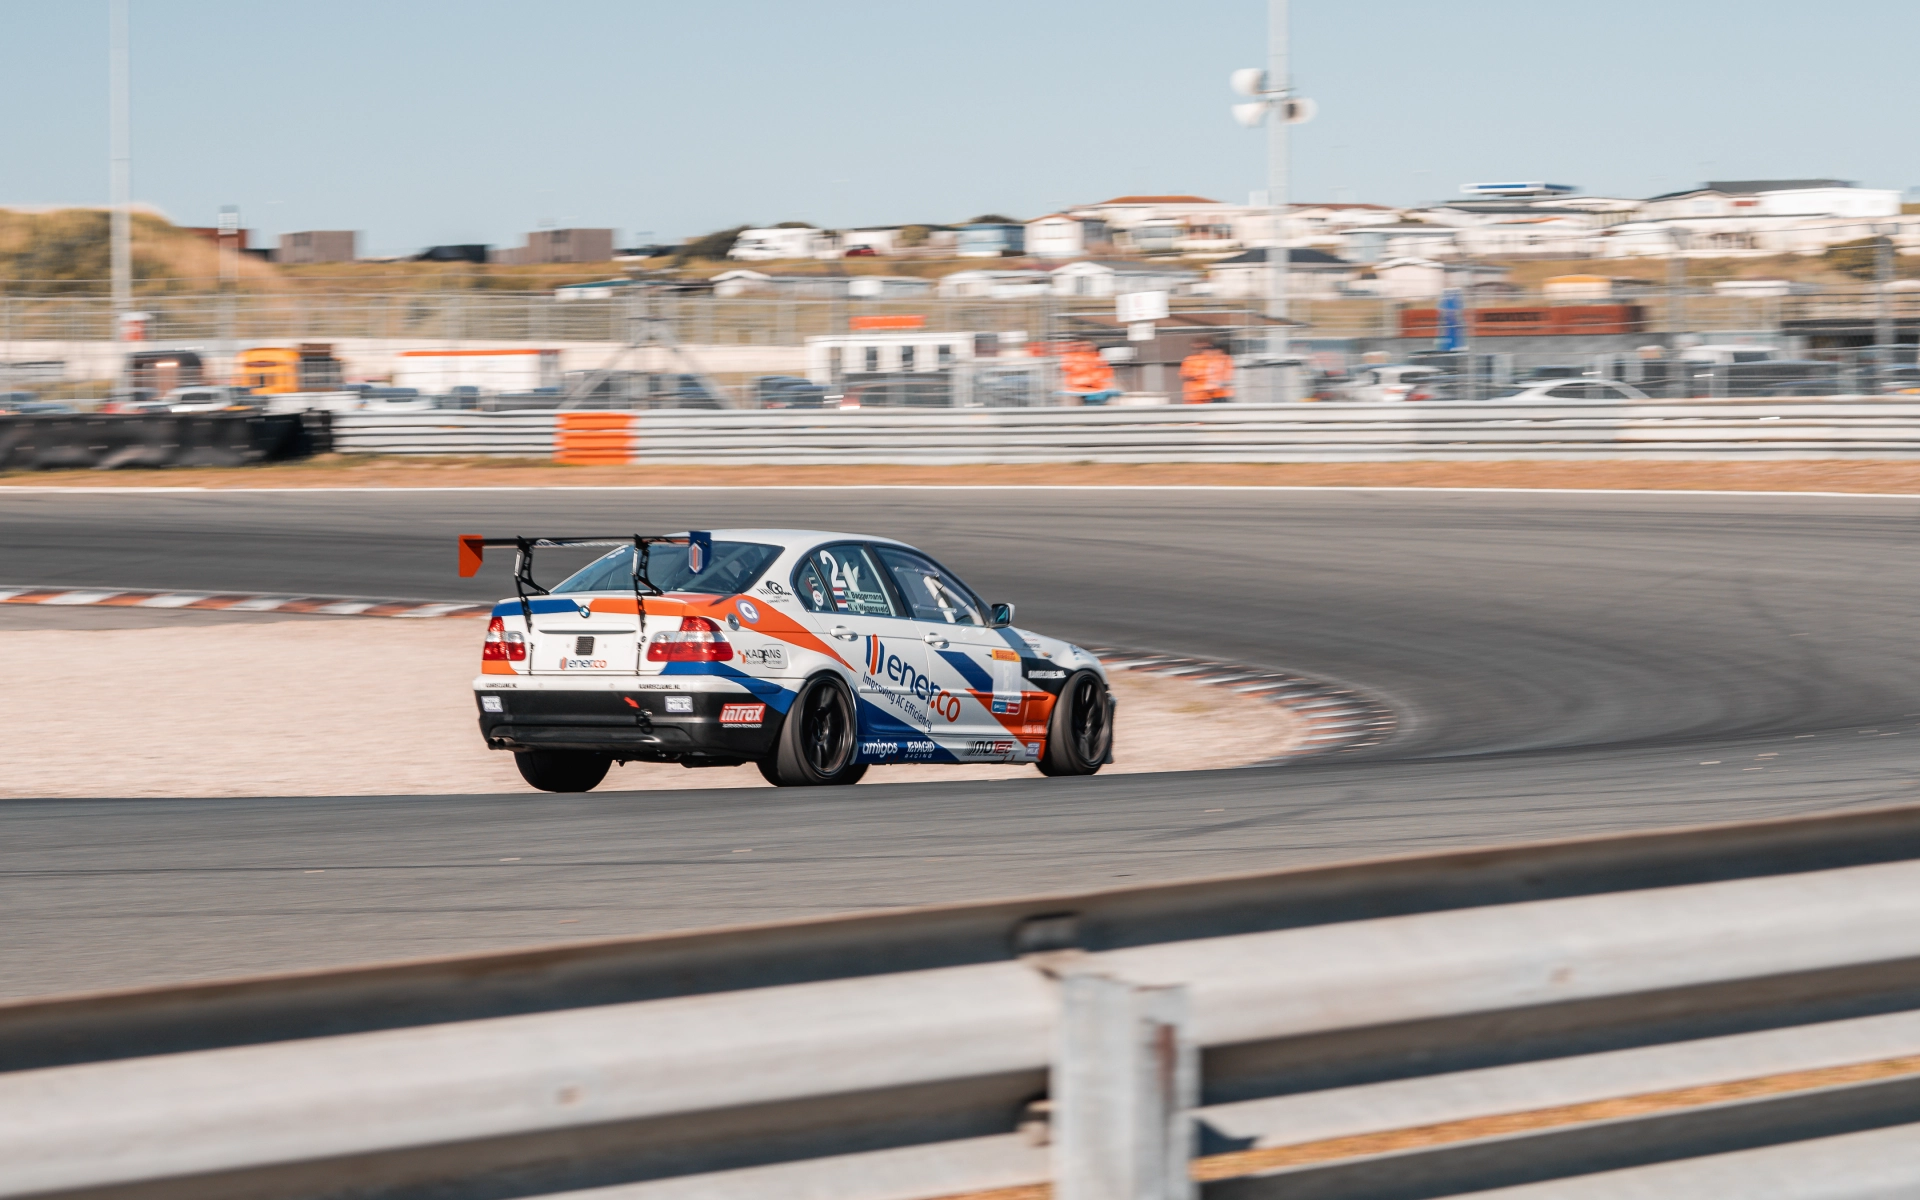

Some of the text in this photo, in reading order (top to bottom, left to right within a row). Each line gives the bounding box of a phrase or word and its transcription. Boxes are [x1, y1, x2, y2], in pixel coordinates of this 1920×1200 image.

[820, 550, 848, 588] 2
[745, 649, 782, 659] KADANS
[863, 671, 933, 732] Improving AC Efficiency
[887, 654, 961, 723] ener.co
[863, 739, 898, 758] amigos
